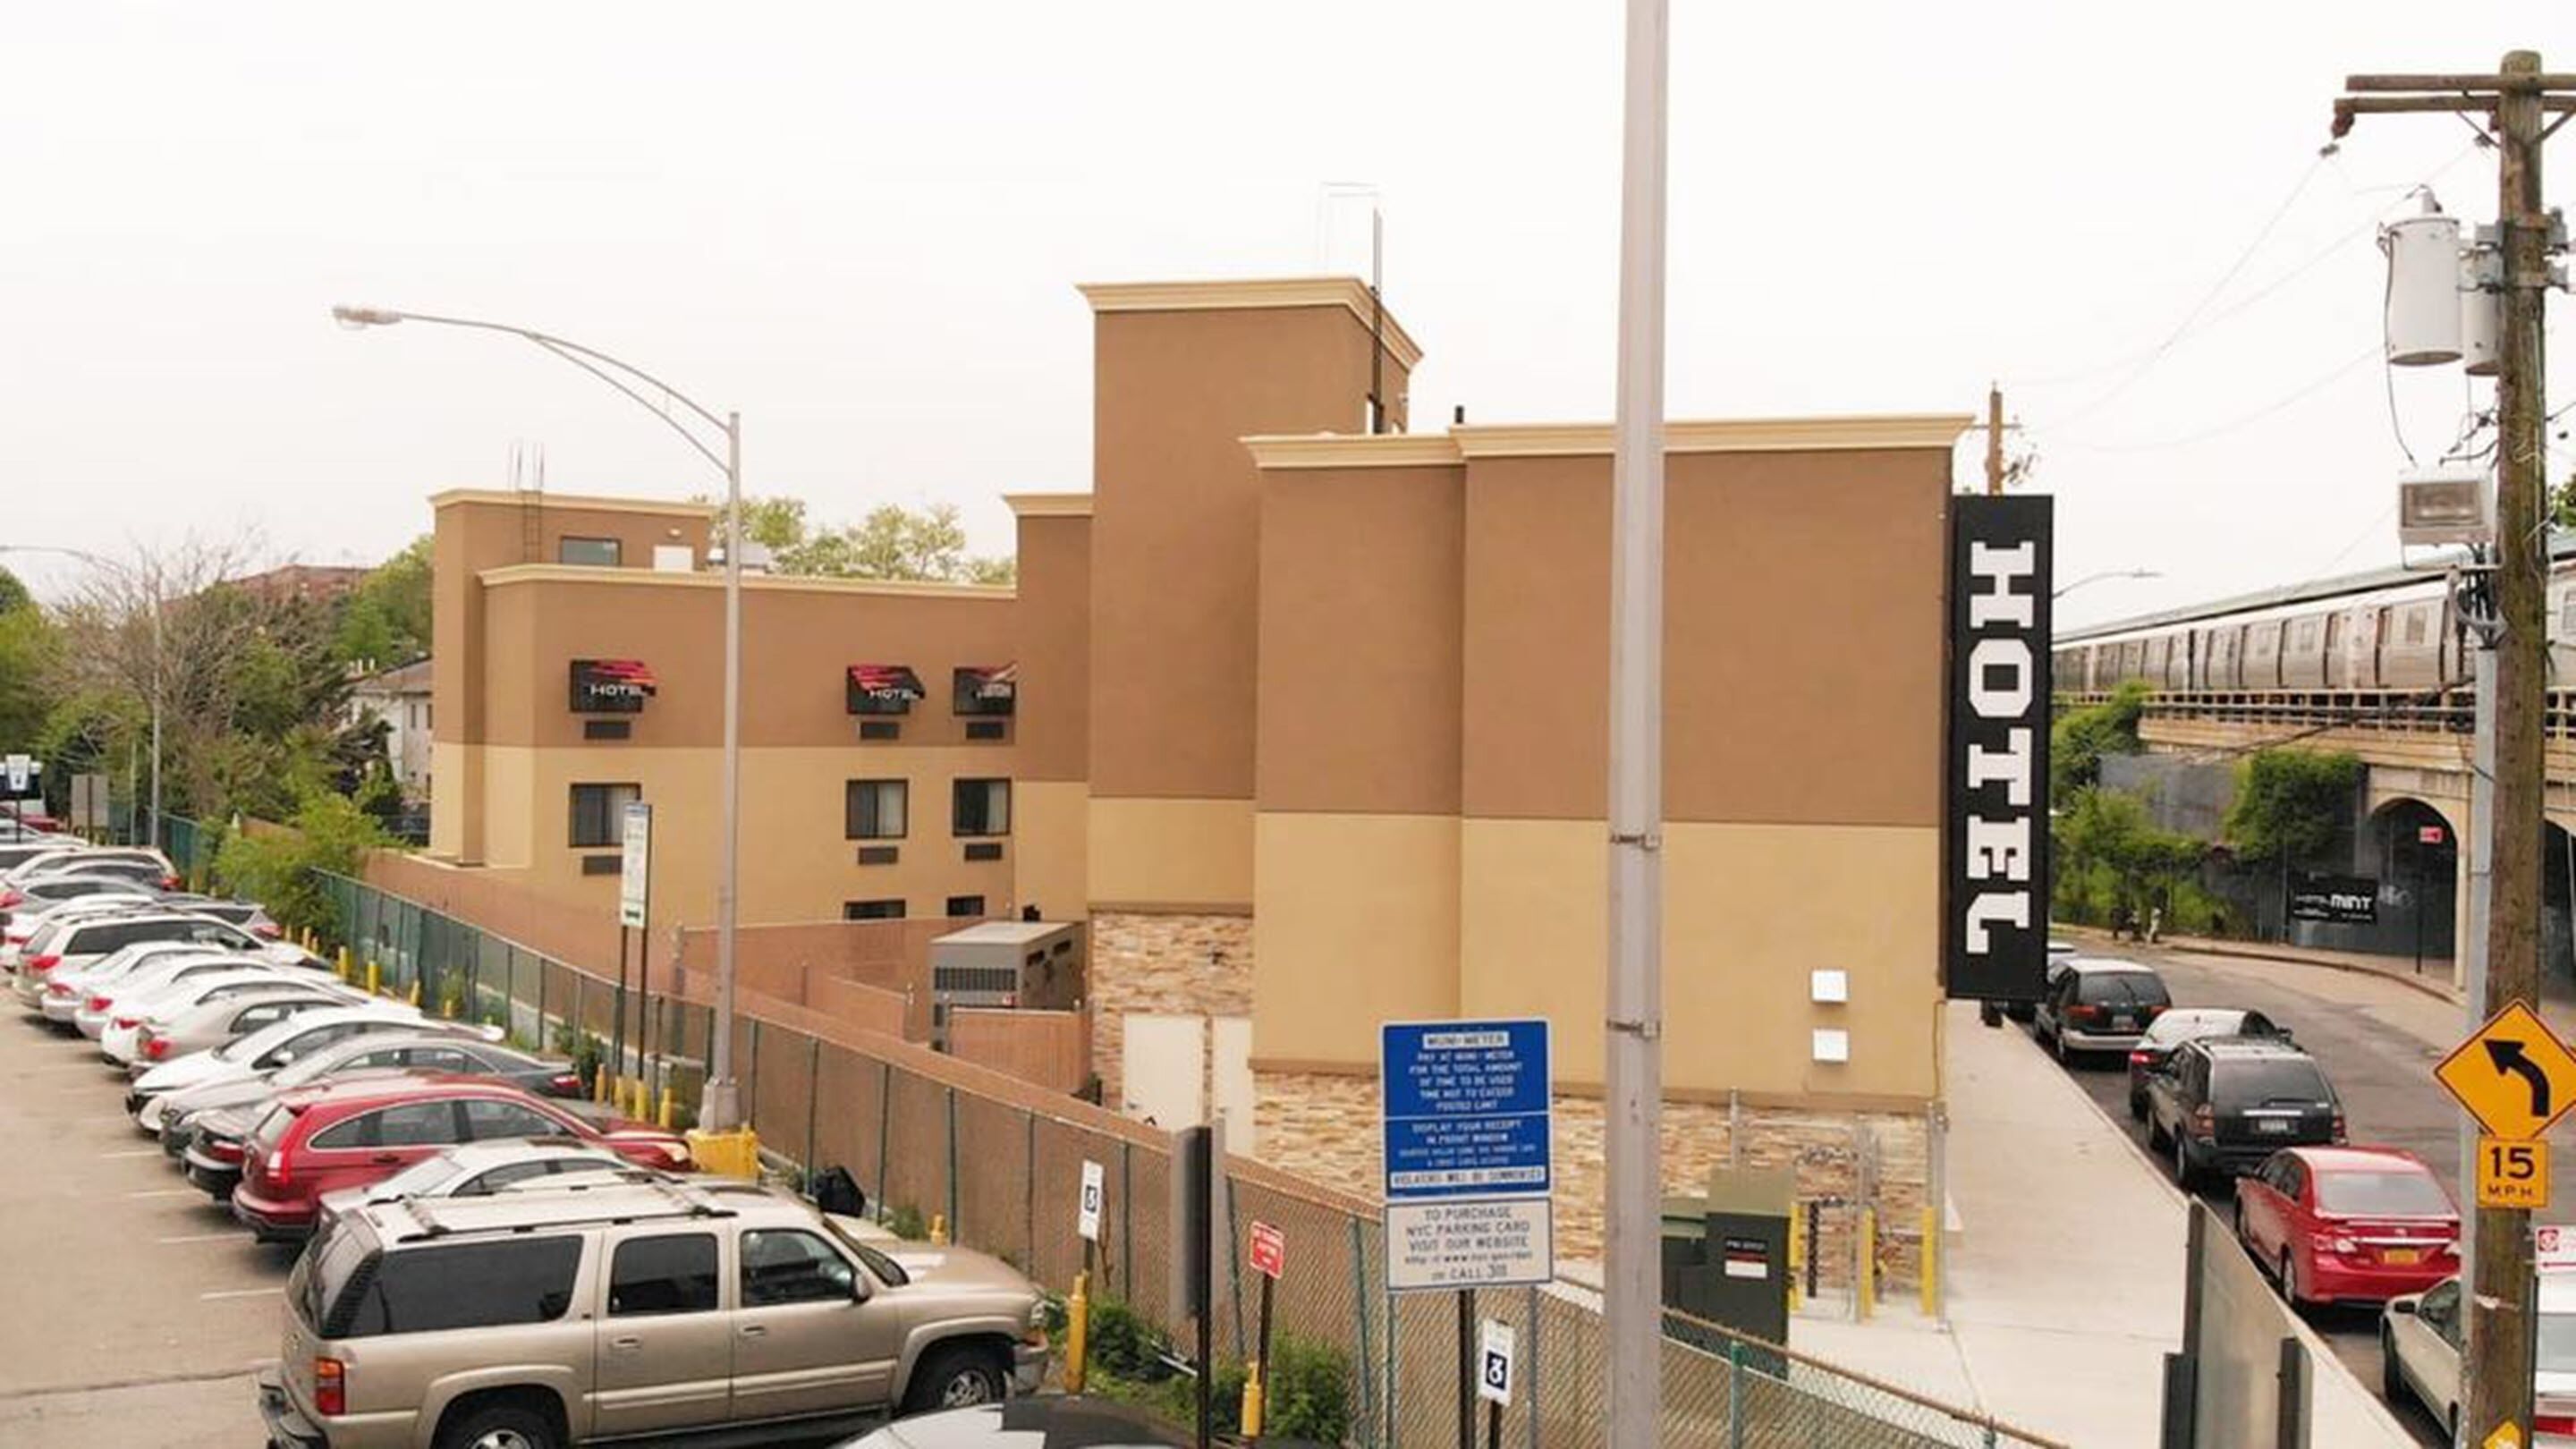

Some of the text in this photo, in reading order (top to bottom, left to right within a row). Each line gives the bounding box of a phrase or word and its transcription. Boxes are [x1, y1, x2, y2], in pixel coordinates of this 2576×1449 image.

[590, 684, 648, 697] HOTEL
[869, 688, 920, 700] HOTEL
[1966, 540, 2035, 953] HOTEL
[2490, 1146, 2535, 1180] 15
[1424, 1207, 1511, 1221] TO PURCHASE
[1406, 1220, 1530, 1237] NYC PARKING CARD
[1410, 1235, 1530, 1251] VISIT OUR WEBSITE
[1449, 1266, 1480, 1279] CALL
